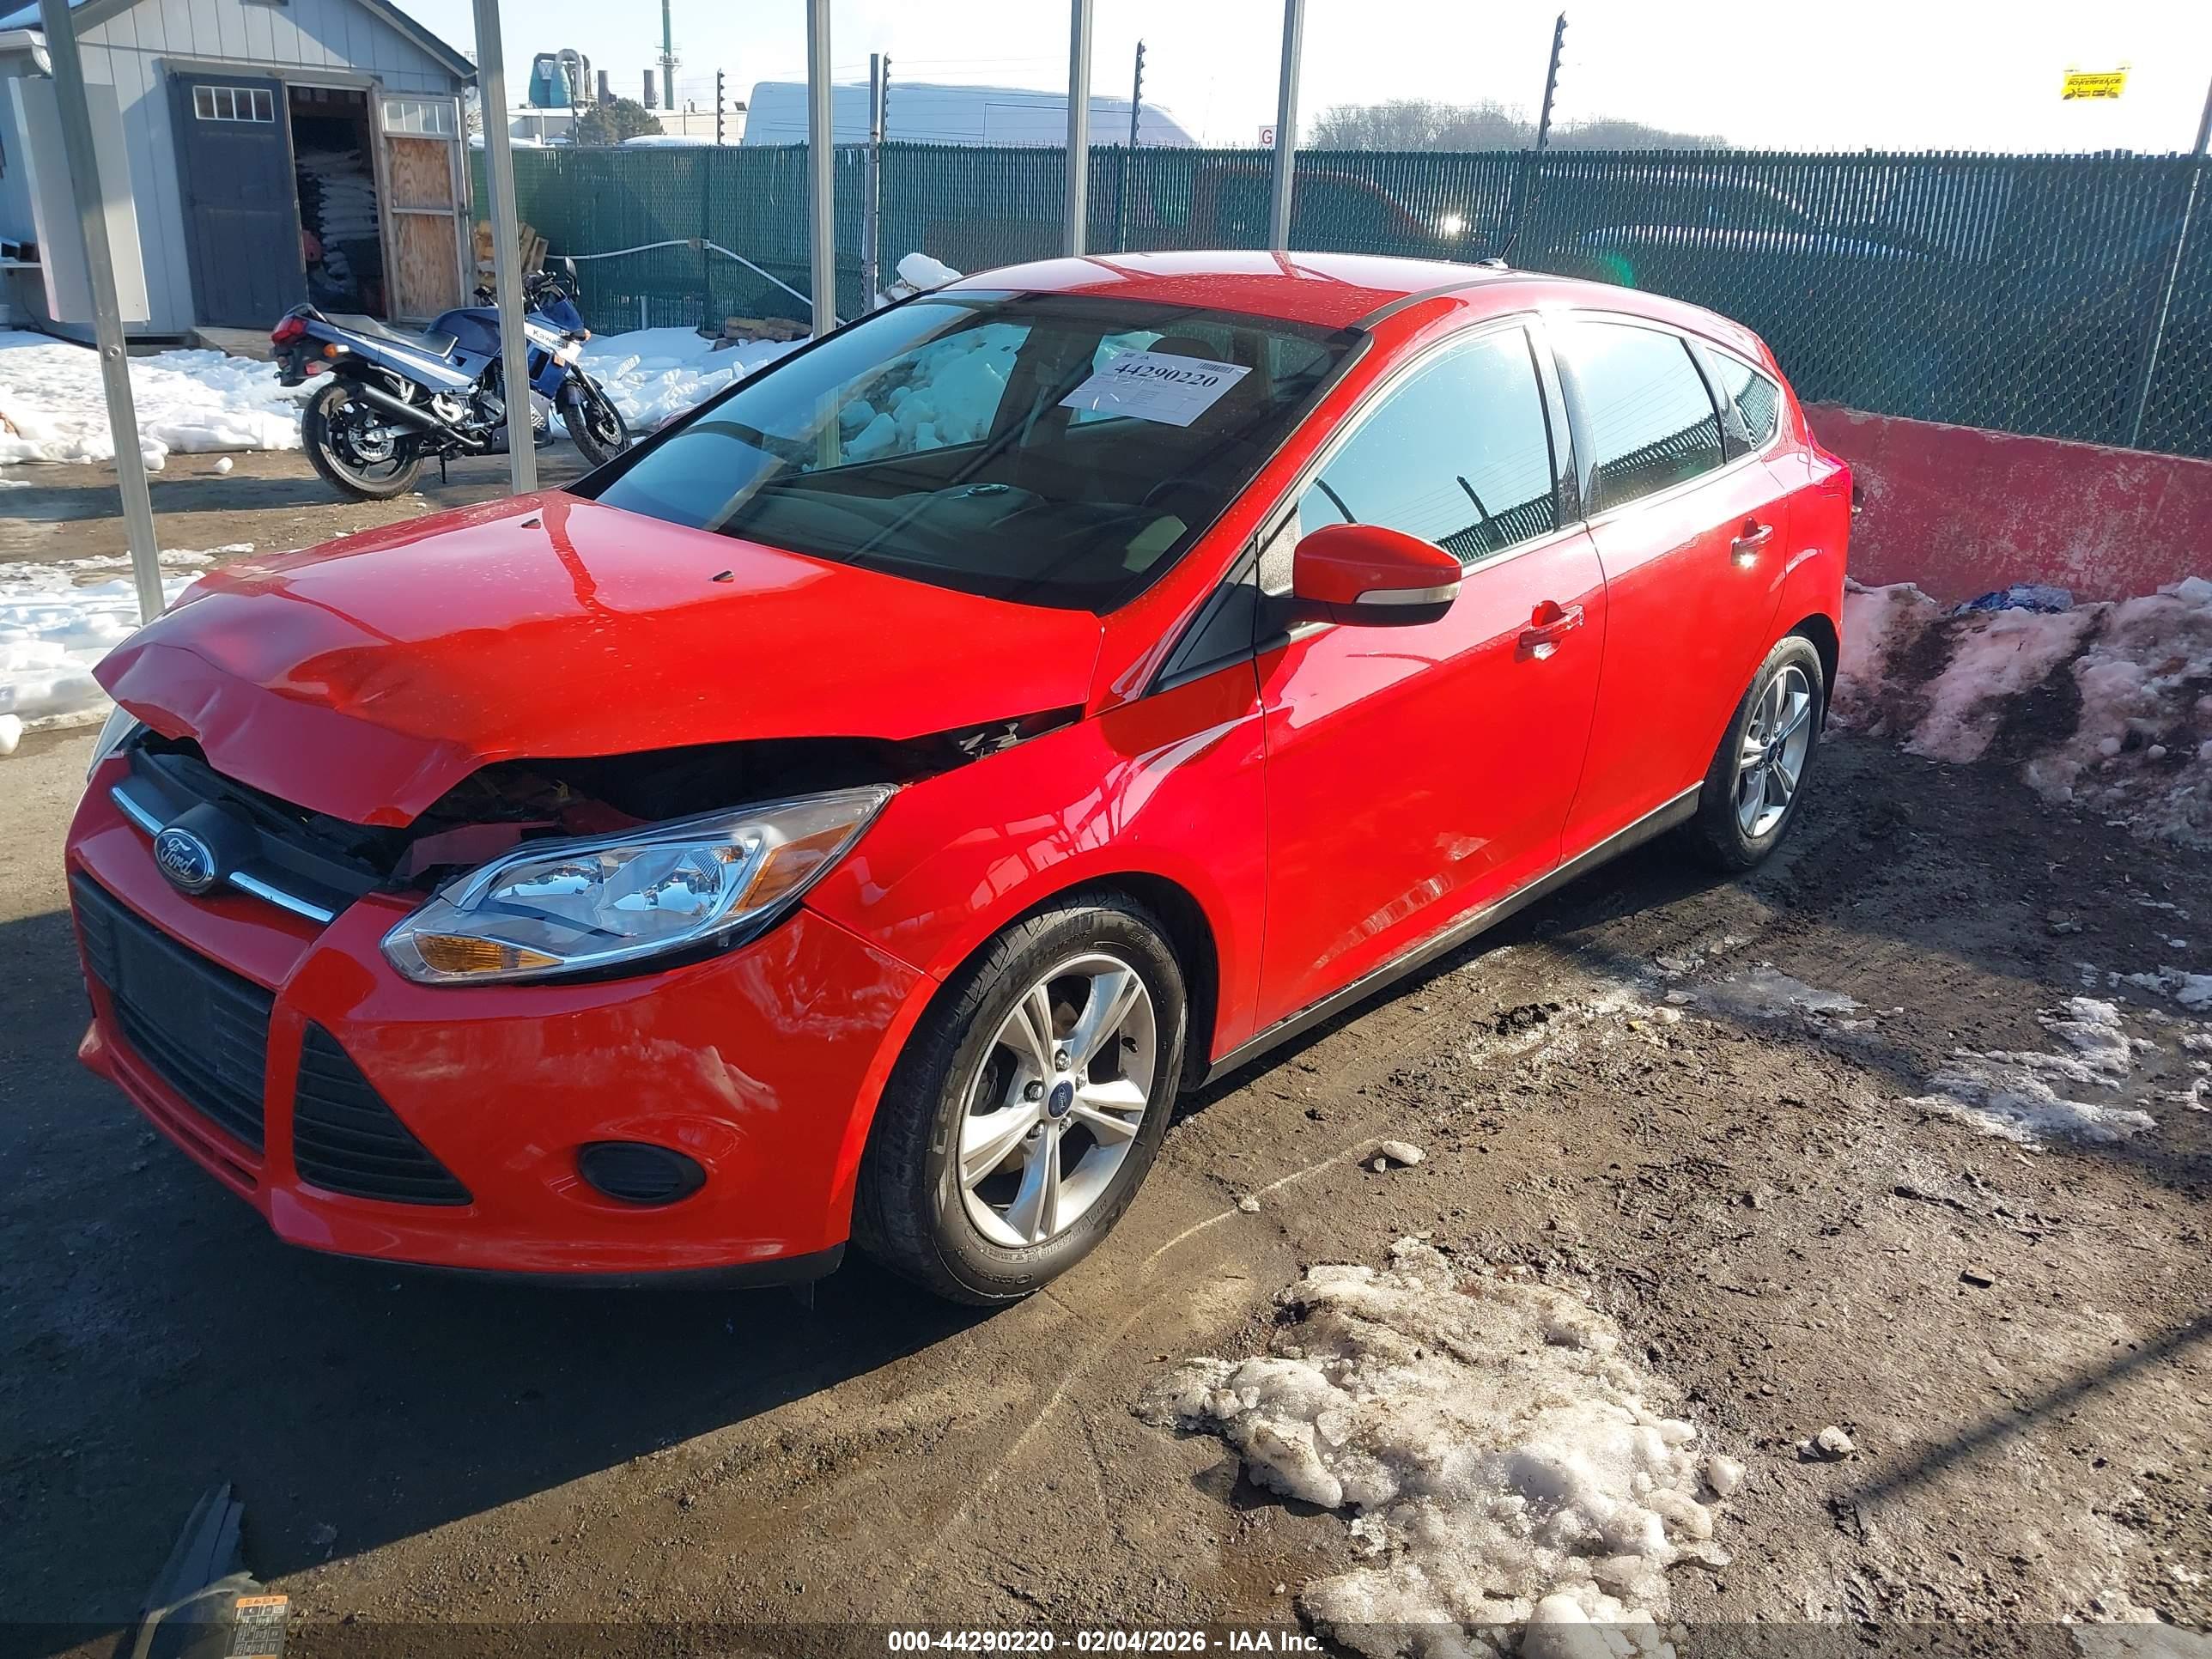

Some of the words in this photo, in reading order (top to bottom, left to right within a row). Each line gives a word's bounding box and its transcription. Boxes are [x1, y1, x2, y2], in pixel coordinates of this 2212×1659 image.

[1262, 129, 1273, 144] G
[1114, 363, 1219, 387] 44290220
[161, 837, 197, 876] Ford
